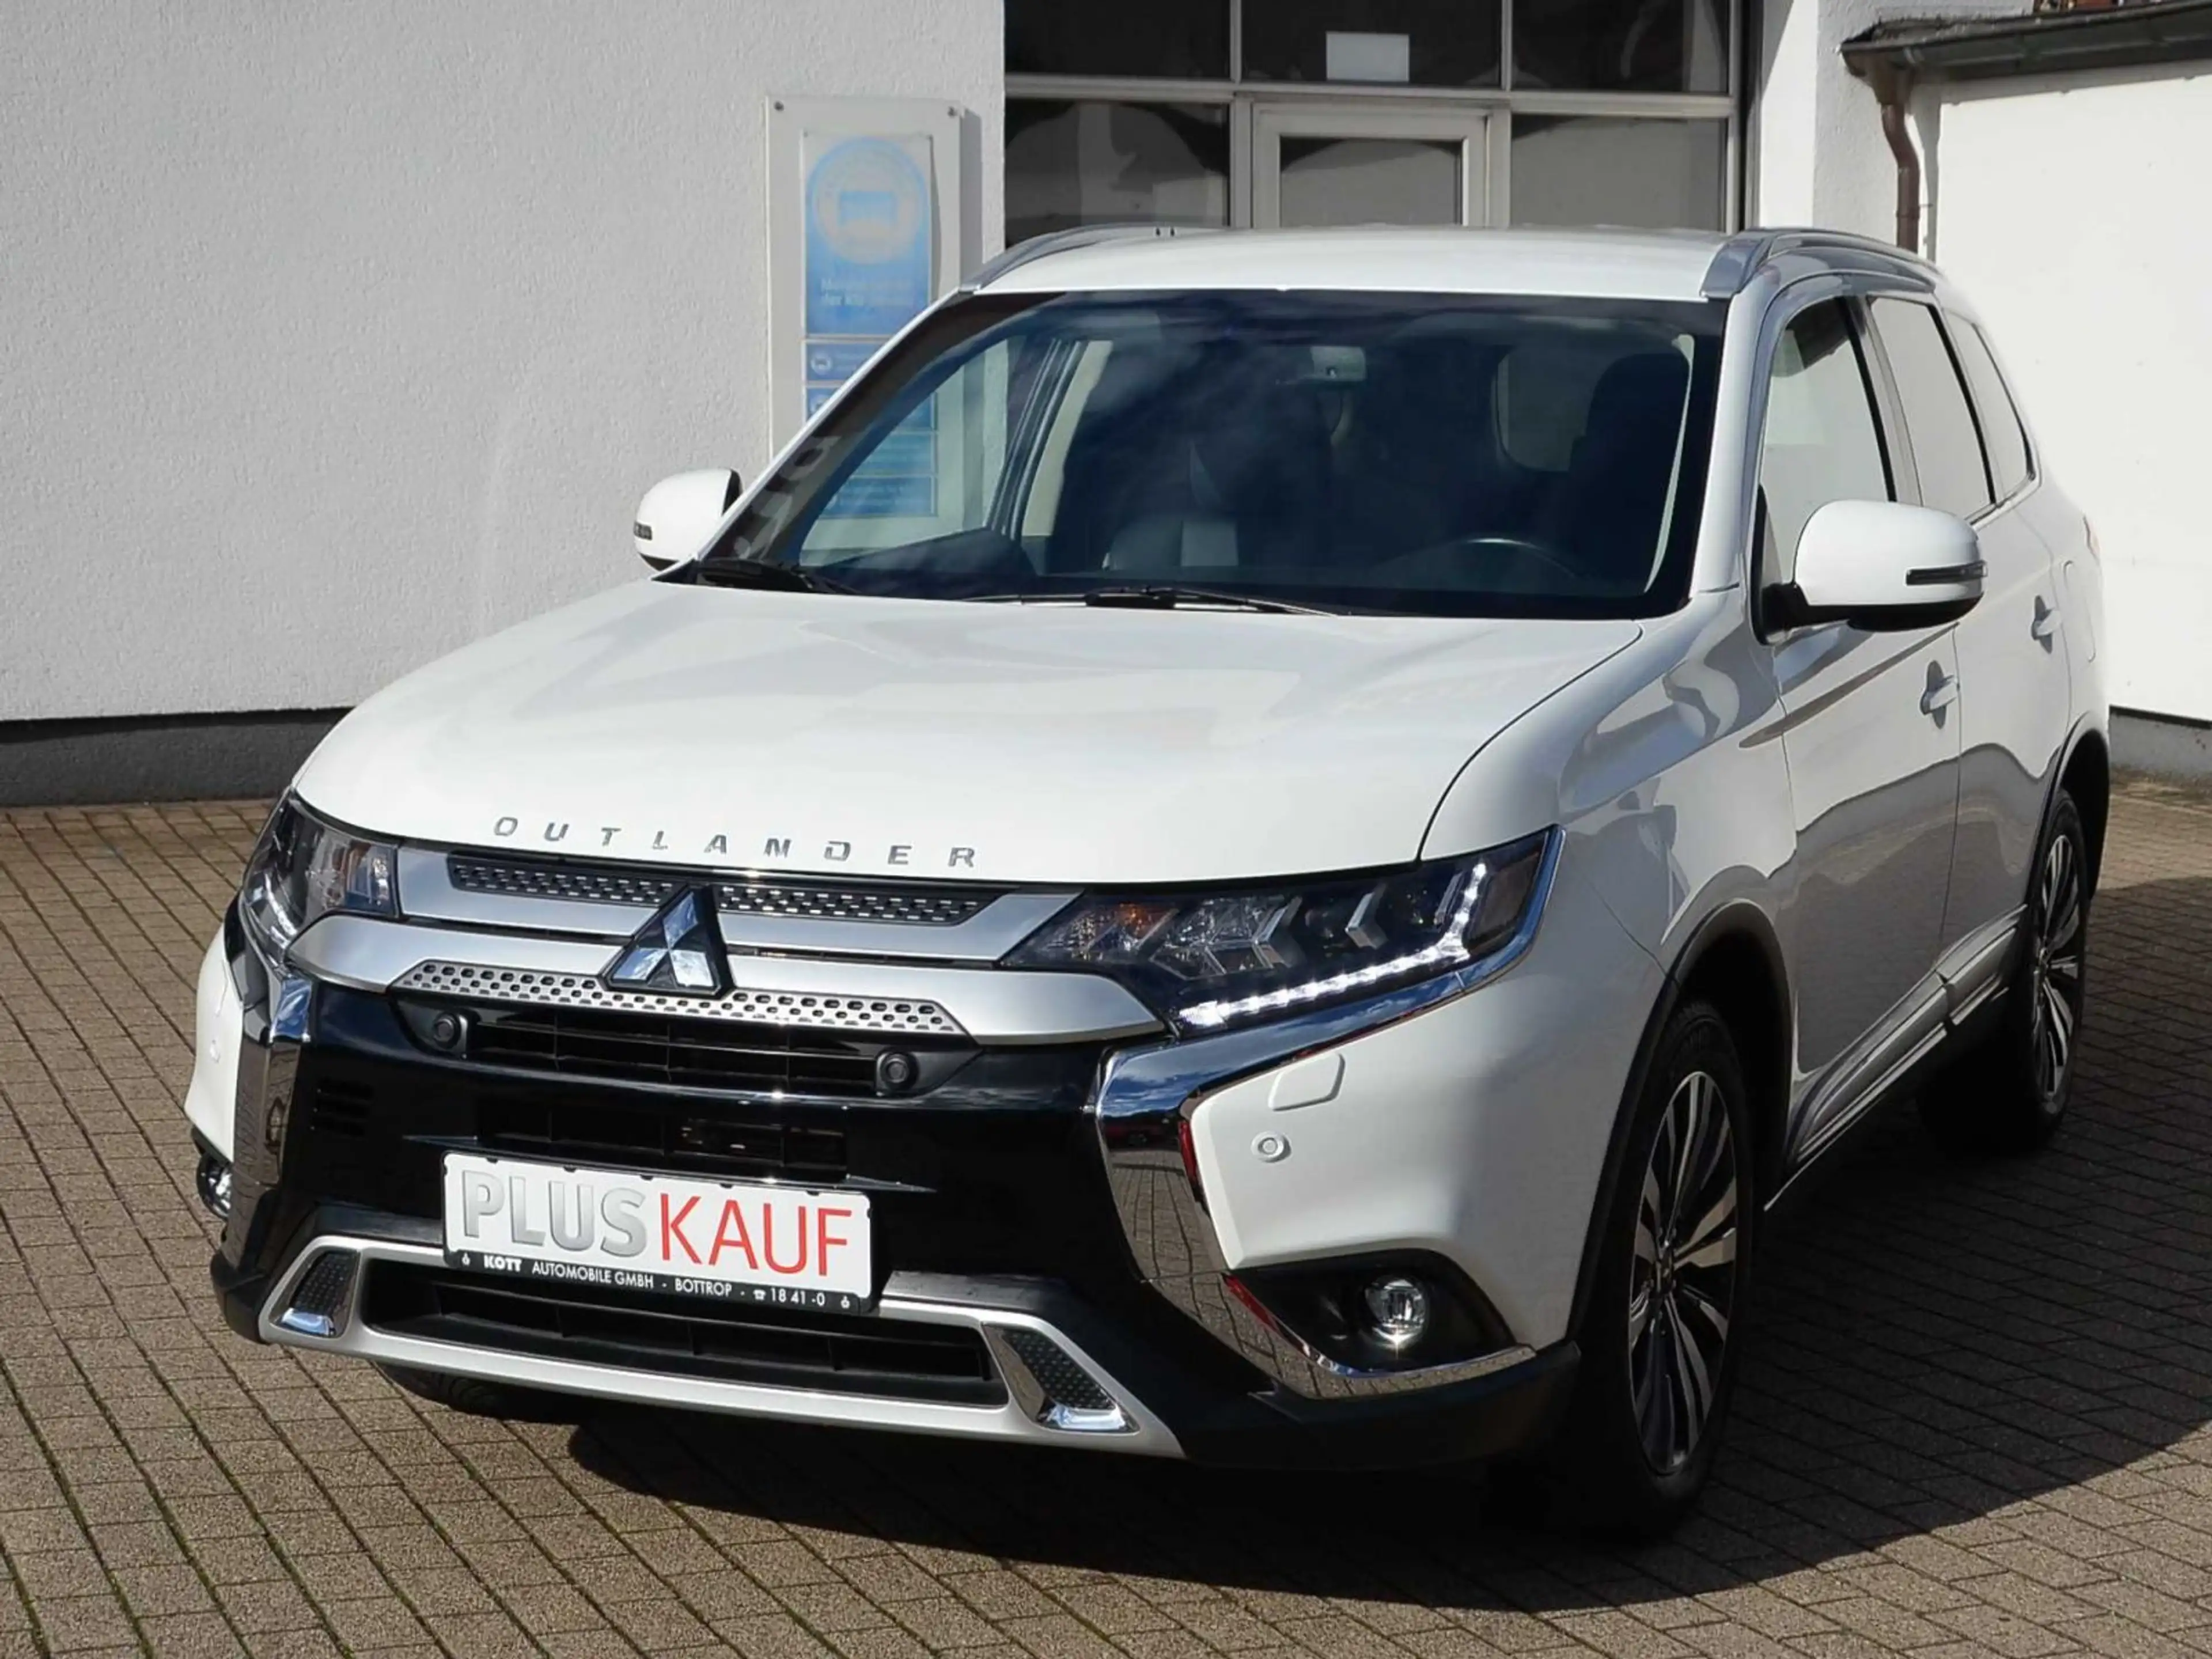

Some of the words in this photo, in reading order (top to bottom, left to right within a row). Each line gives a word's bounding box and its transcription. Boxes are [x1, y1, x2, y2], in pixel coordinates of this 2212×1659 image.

[494, 816, 976, 868] OUTLANDER
[484, 1255, 522, 1272] KOTT
[532, 1262, 612, 1283] AUTOMOBILE
[615, 1272, 654, 1289] GMBH
[675, 1277, 732, 1297] BOTTROP
